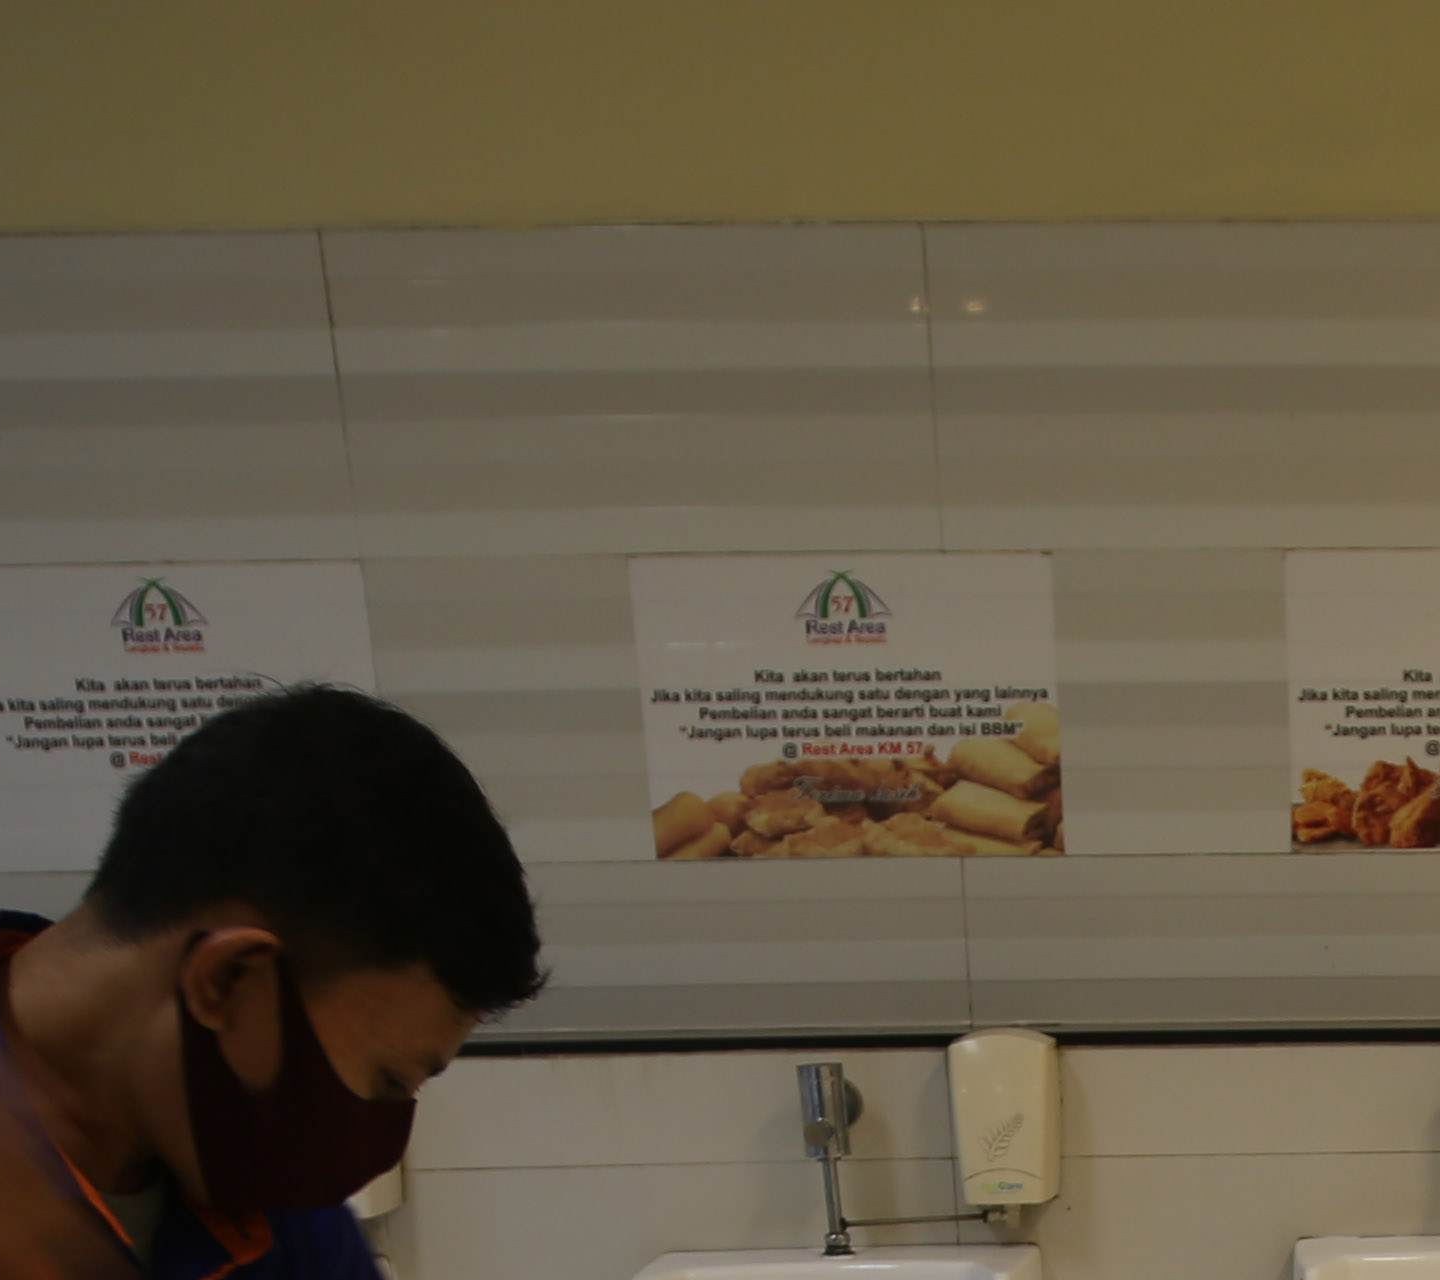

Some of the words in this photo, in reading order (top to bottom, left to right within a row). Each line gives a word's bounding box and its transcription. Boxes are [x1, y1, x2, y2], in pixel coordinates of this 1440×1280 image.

[144, 604, 170, 621] 57
[830, 596, 855, 613] 57
[121, 627, 161, 642] Rest
[162, 627, 203, 642] Area
[805, 619, 844, 634] Rest
[846, 619, 886, 634] Area
[754, 669, 784, 682] Kita
[792, 669, 828, 682] akan
[832, 669, 870, 681] terus
[875, 668, 942, 681] bertahan
[1403, 669, 1431, 681] Kita
[75, 678, 105, 691] Kita
[112, 677, 150, 690] akan
[152, 677, 192, 690] terus
[195, 676, 263, 690] bertahan
[649, 689, 680, 703] Jika
[684, 689, 711, 702] kita
[715, 689, 761, 704] saling
[765, 688, 853, 704] mendukung
[857, 687, 890, 700] satu
[893, 687, 950, 703] dengan
[954, 688, 990, 702] yang
[994, 686, 1048, 702] lainnya
[1297, 688, 1327, 700] Jika
[1332, 688, 1358, 700] kita
[1363, 688, 1407, 702] saling
[7, 698, 35, 710] kita
[38, 697, 84, 713] saling
[87, 696, 176, 713] mendukung
[179, 696, 213, 709] satu
[699, 706, 777, 720] Pembelian
[781, 706, 817, 719] anda
[822, 706, 872, 721] sangat
[876, 705, 925, 718] berarti
[928, 704, 962, 718] buat
[965, 704, 1002, 717] kami
[1345, 705, 1422, 717] Pembelian
[23, 715, 102, 729] Pembelian
[105, 714, 142, 728] anda
[145, 715, 197, 730] sangat
[745, 725, 778, 740] lupa
[782, 725, 820, 738] terus
[824, 724, 851, 737] beli
[855, 723, 923, 736] makanan
[927, 723, 955, 736] dan
[958, 723, 976, 735] isi
[1390, 723, 1421, 738] lupa
[71, 734, 105, 750] lupa
[107, 734, 146, 747] terus
[149, 733, 178, 747] beli
[781, 741, 798, 758] @
[801, 741, 835, 755] Rest
[838, 741, 873, 754] Area
[877, 741, 902, 754] KM
[906, 741, 924, 754] 57
[1425, 739, 1440, 756] @
